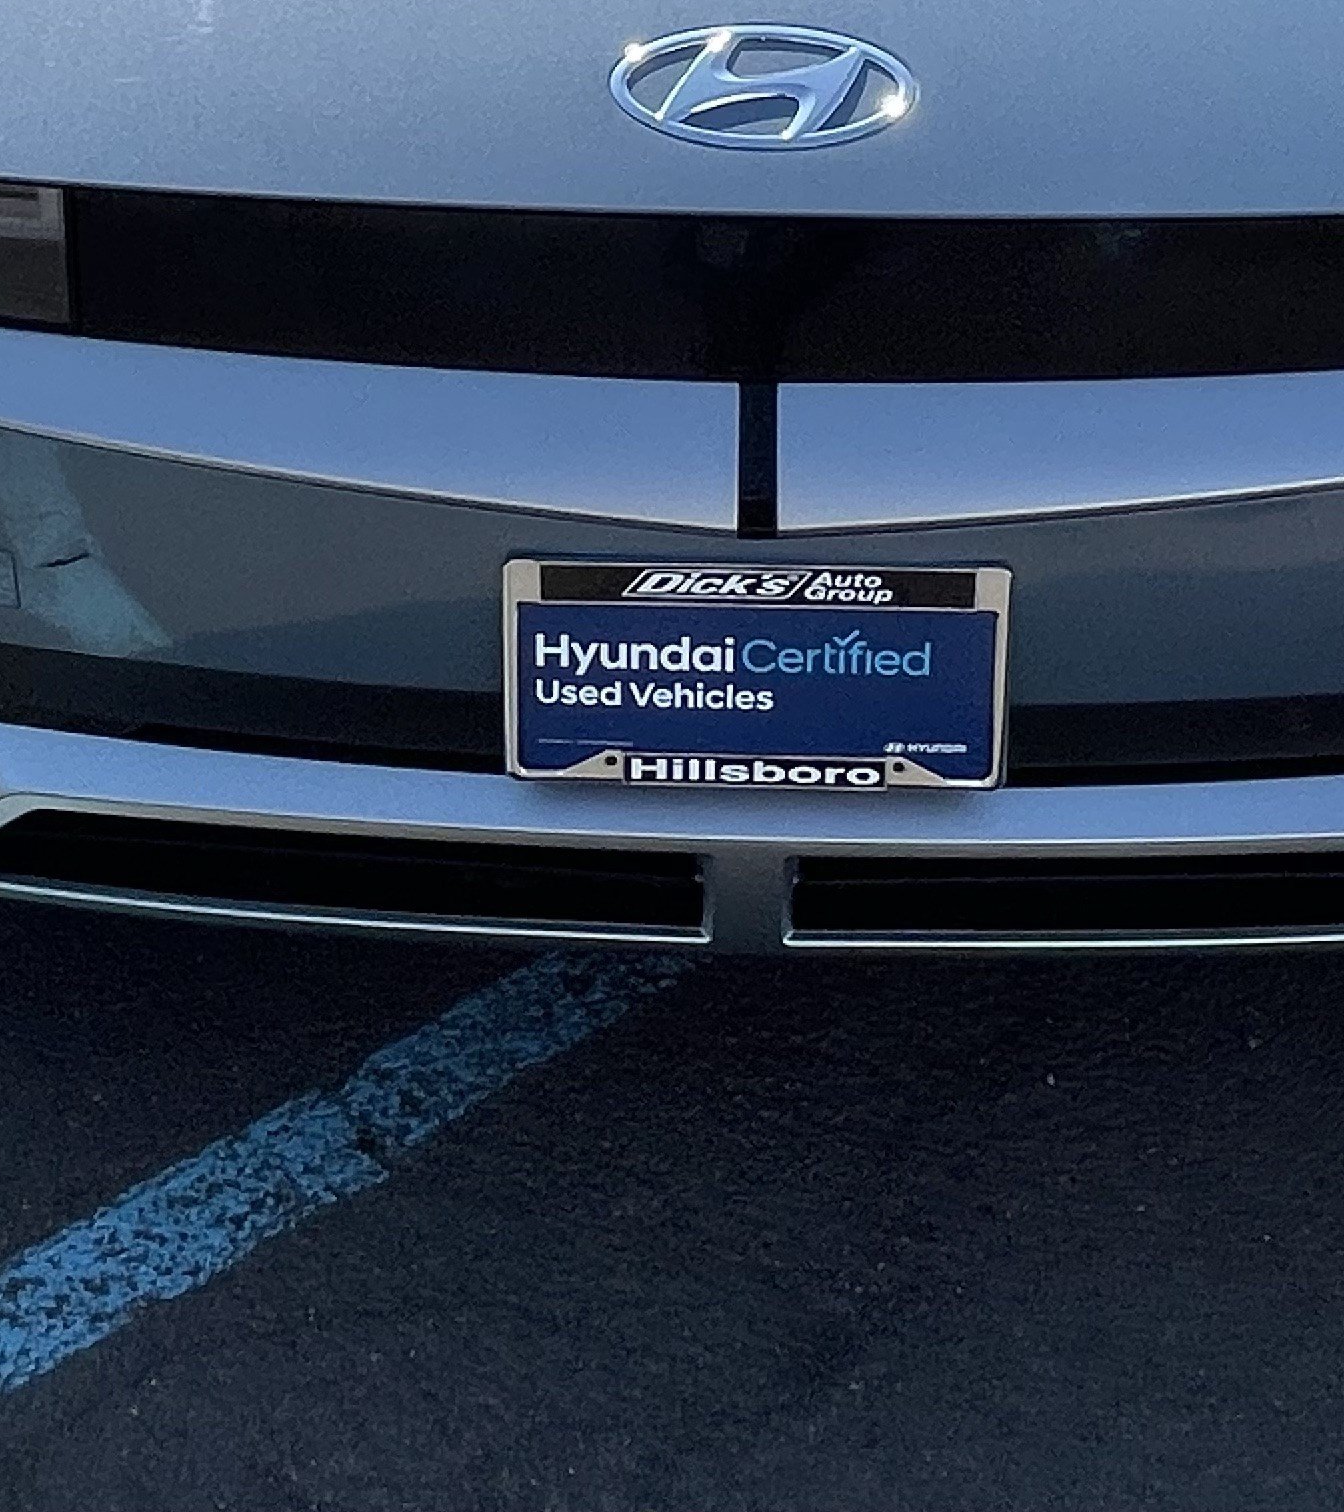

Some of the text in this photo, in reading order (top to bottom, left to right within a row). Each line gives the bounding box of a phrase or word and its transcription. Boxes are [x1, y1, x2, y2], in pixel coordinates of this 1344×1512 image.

[636, 571, 790, 597] Dick's
[811, 571, 883, 589] Auto
[805, 587, 894, 605] Group
[534, 633, 933, 677] Hyundai Certified
[535, 679, 775, 710] Used Vehicles
[631, 757, 880, 785] Hillsboro
